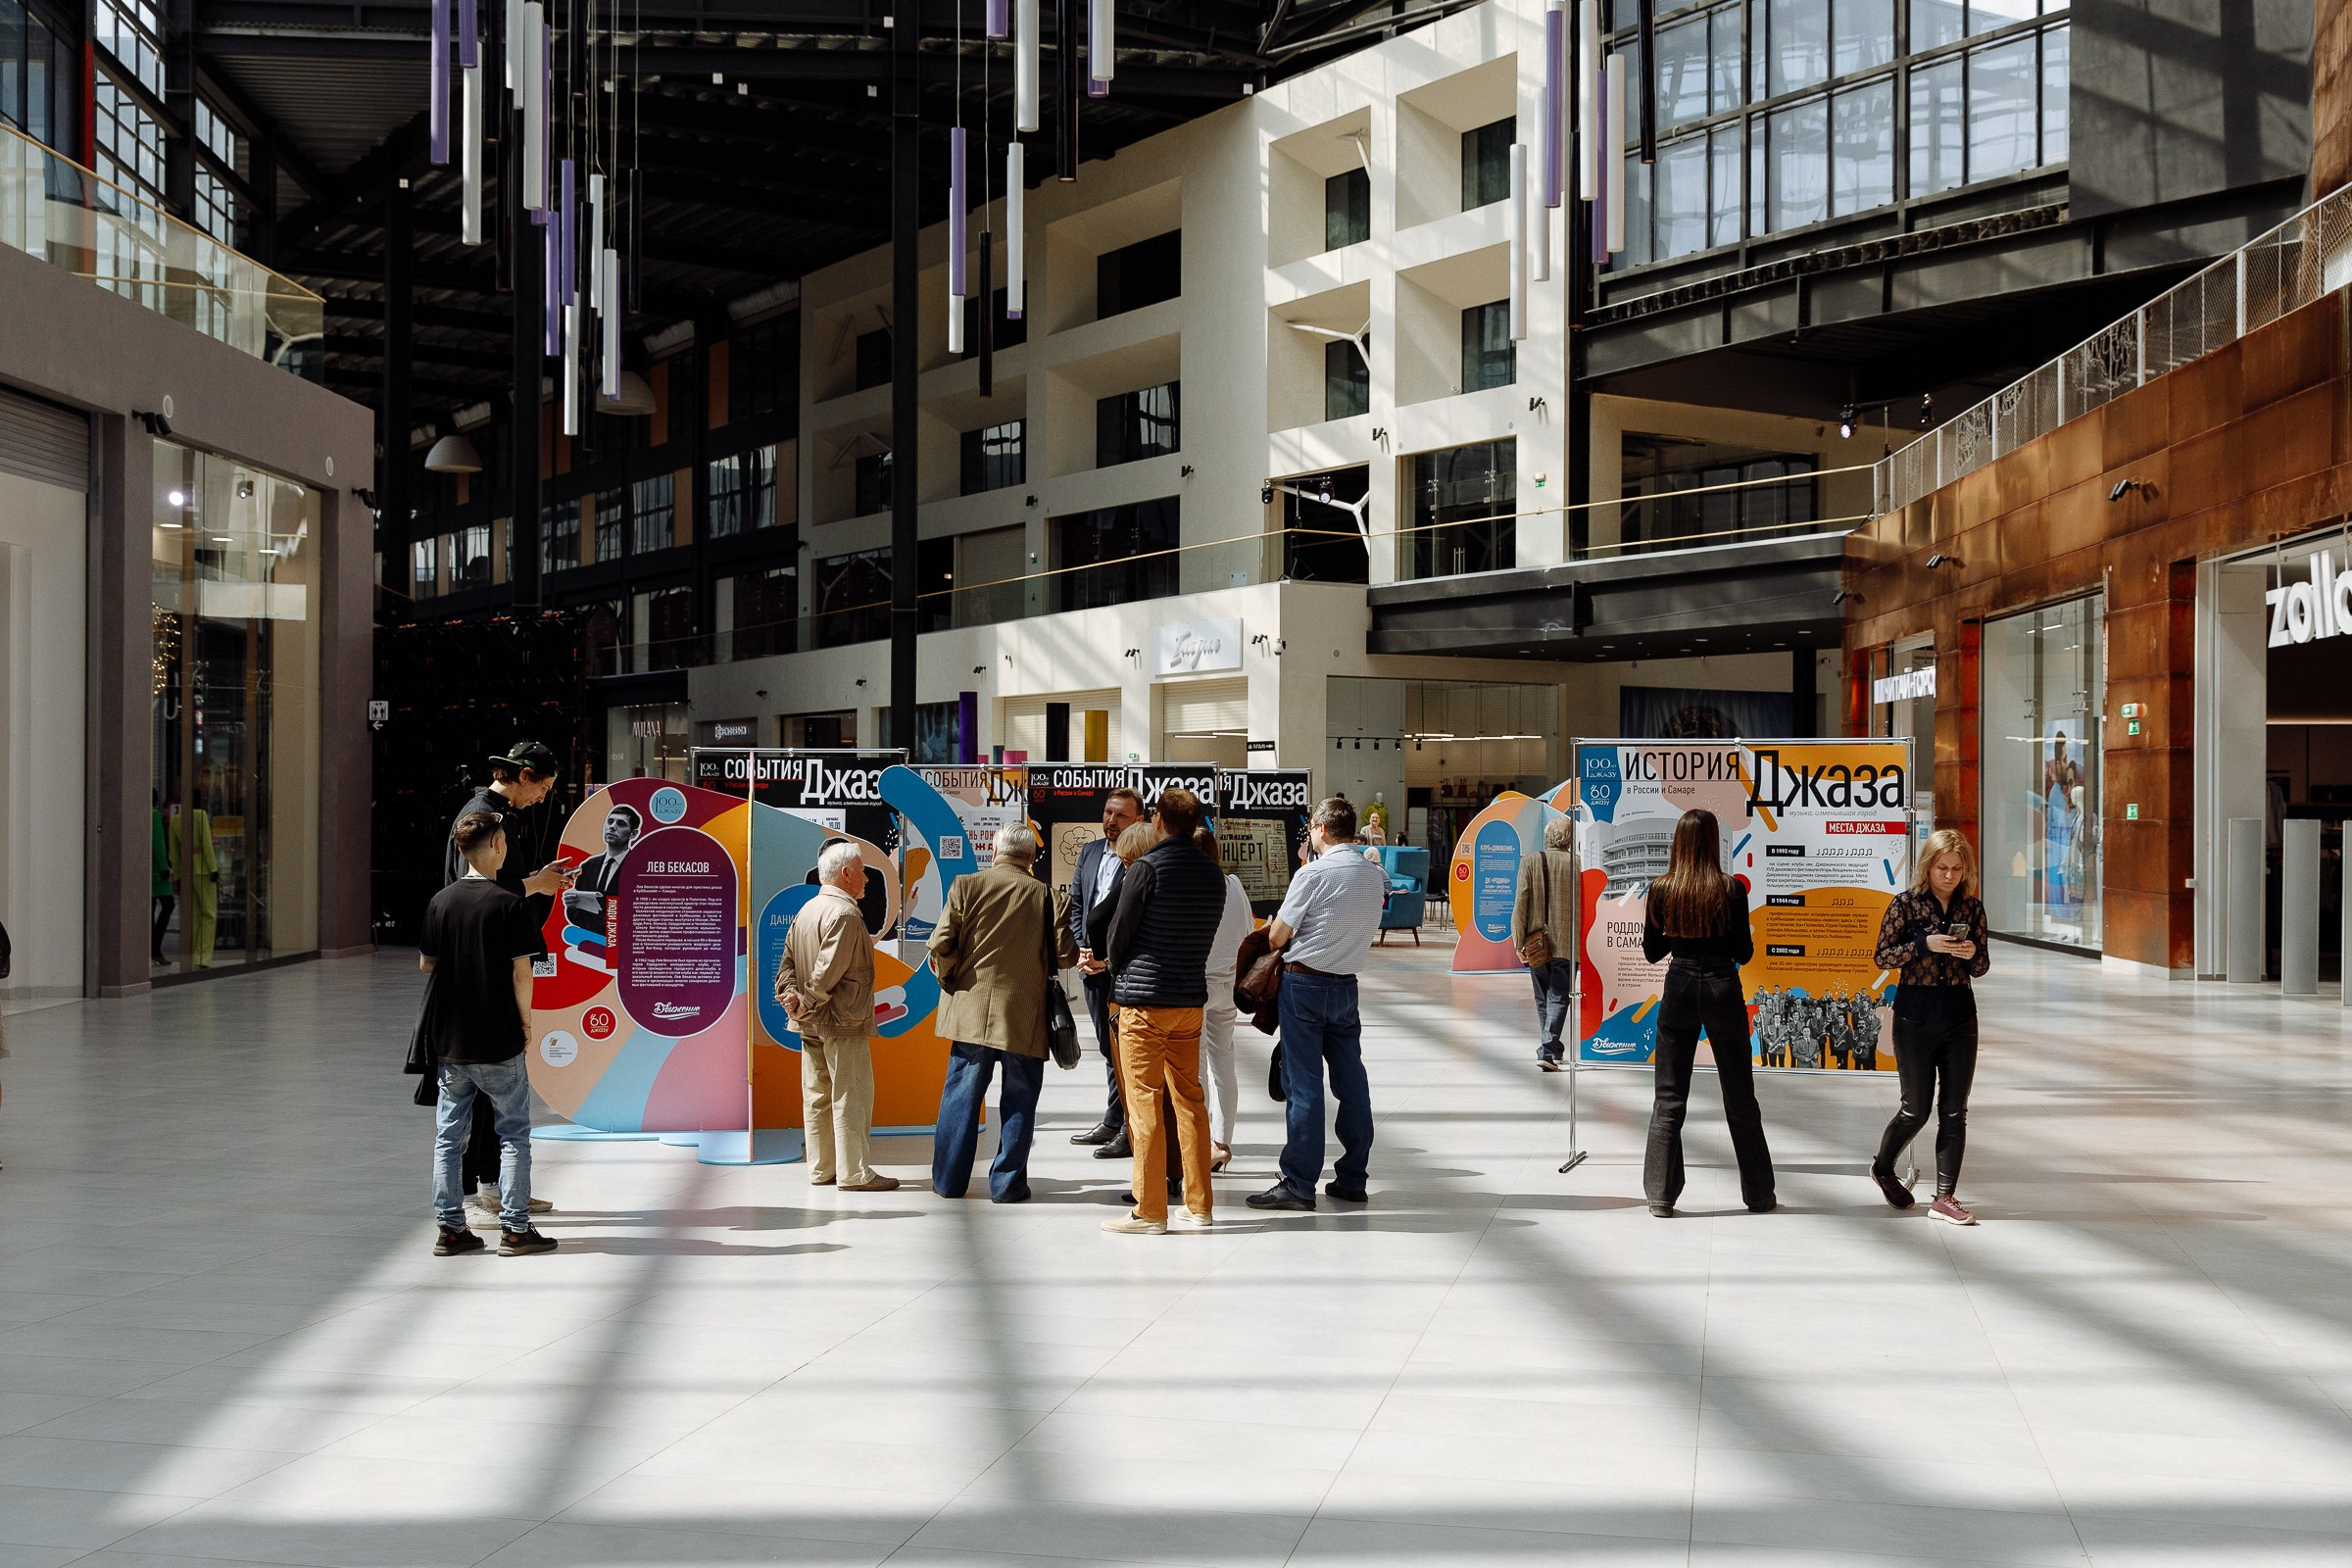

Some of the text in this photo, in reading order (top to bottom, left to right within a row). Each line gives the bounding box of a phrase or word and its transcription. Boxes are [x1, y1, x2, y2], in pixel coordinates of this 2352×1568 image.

[632, 720, 661, 738] MILANA
[800, 759, 882, 805] Джаз
[925, 771, 987, 787] СОБЫТИЯ
[1053, 769, 1125, 788] СОБЫТИЯ
[1625, 750, 1904, 817] ИСТОРИЯ Джаза
[1230, 774, 1308, 810] Джаза
[1633, 785, 1659, 794] России
[1668, 785, 1695, 796] Самаре
[980, 830, 995, 840] РОЖ
[1829, 823, 1886, 833] МЕСТА ДЖАЗА
[1222, 843, 1263, 865] НЦЕРТ
[646, 861, 709, 873] ЛЕВ БЕКАСОВ
[607, 899, 617, 948] ЛЮДИ ДЖАЗА
[770, 915, 795, 926] ДАНИ
[1608, 936, 1644, 948] В САМА
